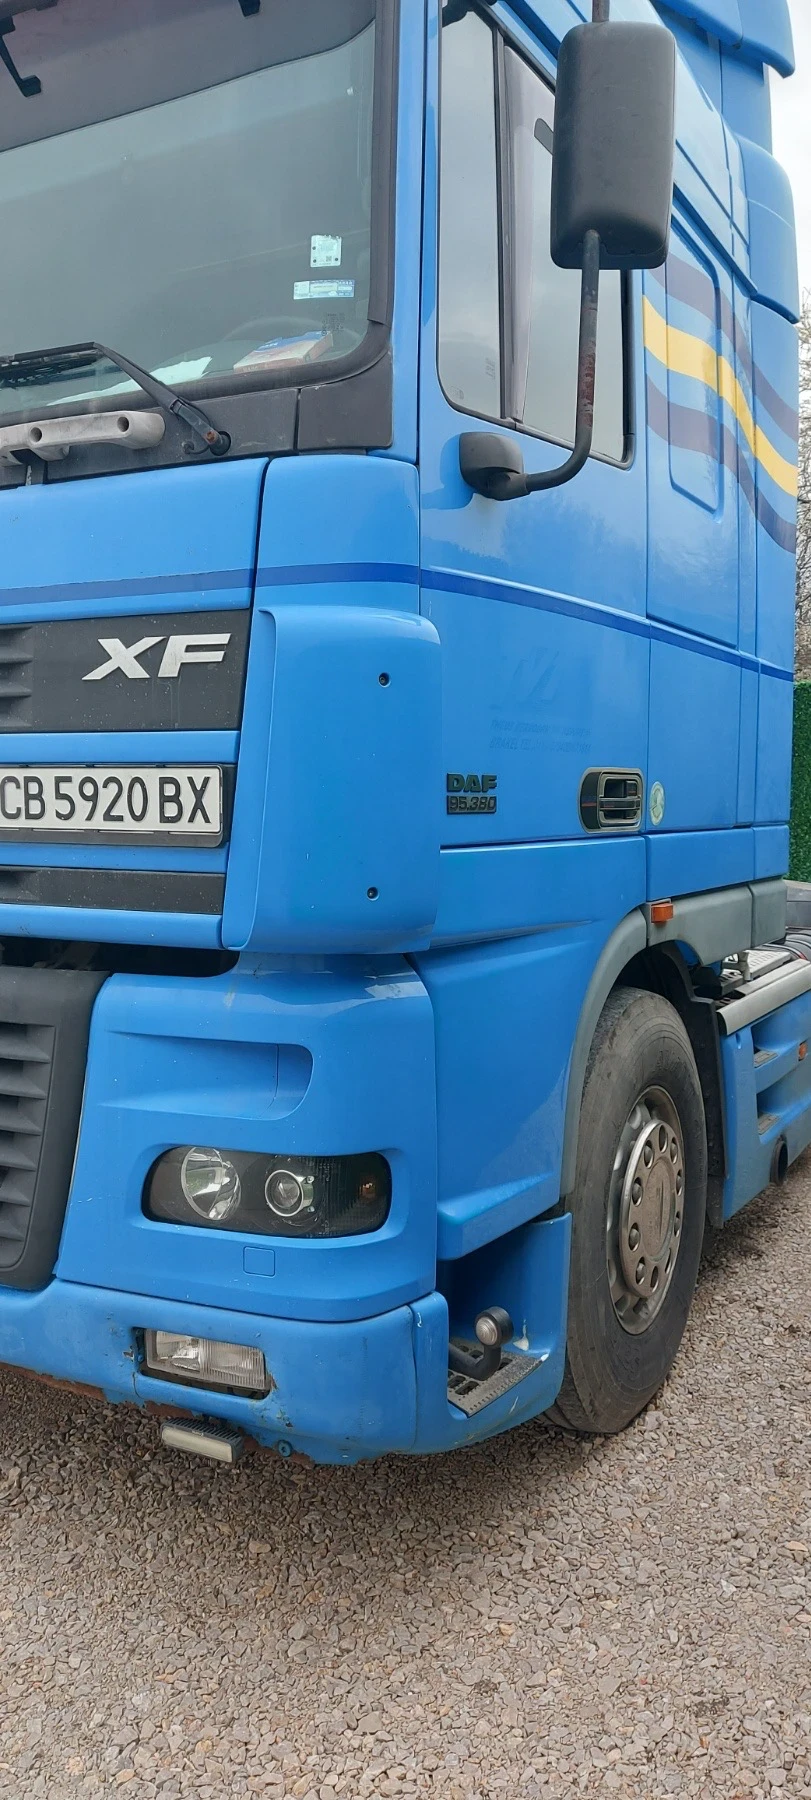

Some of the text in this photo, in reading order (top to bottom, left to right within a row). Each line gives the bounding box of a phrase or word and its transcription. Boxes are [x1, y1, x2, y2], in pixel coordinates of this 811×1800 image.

[82, 633, 232, 681] XF
[447, 773, 497, 792] DAF
[0, 775, 212, 824] CB 5920 BX
[449, 796, 496, 812] 95.380
